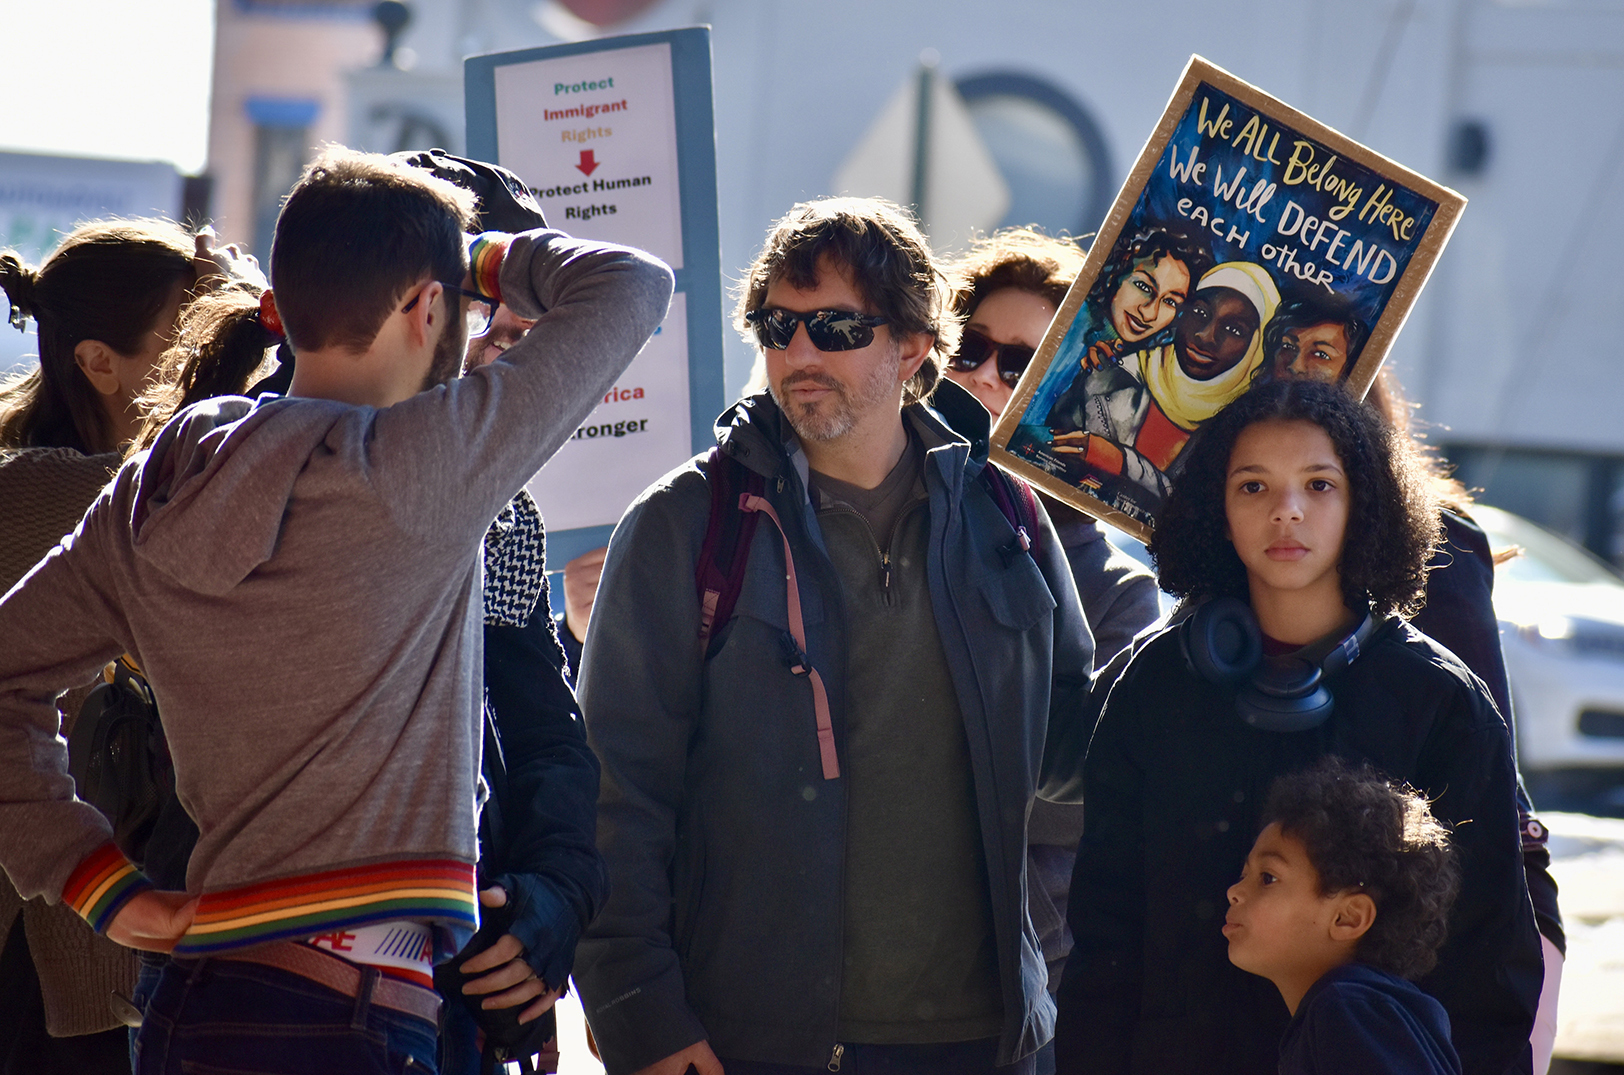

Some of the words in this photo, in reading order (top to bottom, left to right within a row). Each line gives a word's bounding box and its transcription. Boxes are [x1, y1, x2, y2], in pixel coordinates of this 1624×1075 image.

[554, 77, 615, 96] Protect
[543, 99, 628, 121] Immigrant
[560, 126, 613, 143] Rights
[1197, 97, 1234, 140] We
[1231, 115, 1282, 166] ALL
[530, 181, 589, 199] Protect
[592, 175, 652, 192] Human
[1168, 144, 1207, 186] We
[1213, 164, 1278, 224] Will
[565, 203, 617, 220] Rights
[600, 386, 644, 404] rica
